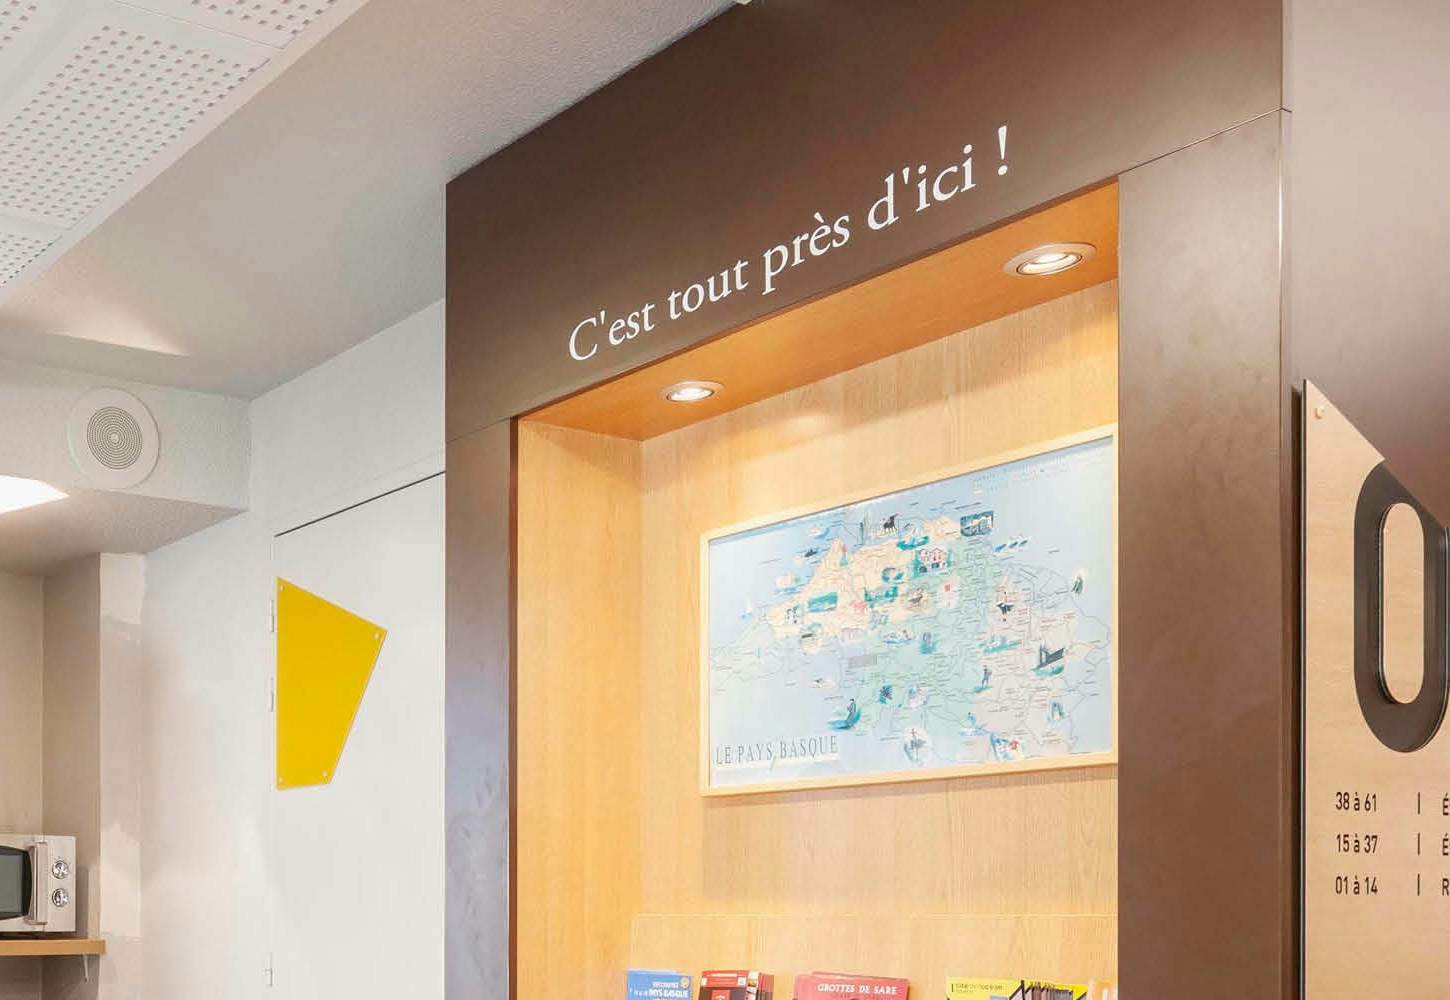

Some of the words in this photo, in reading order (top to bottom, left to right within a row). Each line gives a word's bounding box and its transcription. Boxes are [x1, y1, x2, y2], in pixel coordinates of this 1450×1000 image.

[568, 303, 655, 362] C'est
[667, 259, 749, 320] tout
[761, 211, 851, 295] près
[867, 144, 976, 231] d'ici
[997, 125, 1009, 176] !
[716, 746, 732, 765] LE
[738, 742, 774, 763] PAYS
[779, 735, 839, 758] BASQUE
[1335, 791, 1350, 811] 38
[1353, 791, 1360, 811] à
[1364, 792, 1377, 812] 61
[1335, 834, 1350, 853] 15
[1353, 834, 1360, 853] à
[1364, 835, 1378, 854] 37
[1335, 876, 1350, 895] 01
[1353, 876, 1360, 895] à
[1364, 877, 1378, 896] 14
[818, 983, 855, 993] GROTTES
[859, 985, 870, 994] DE
[874, 986, 898, 995] SARE
